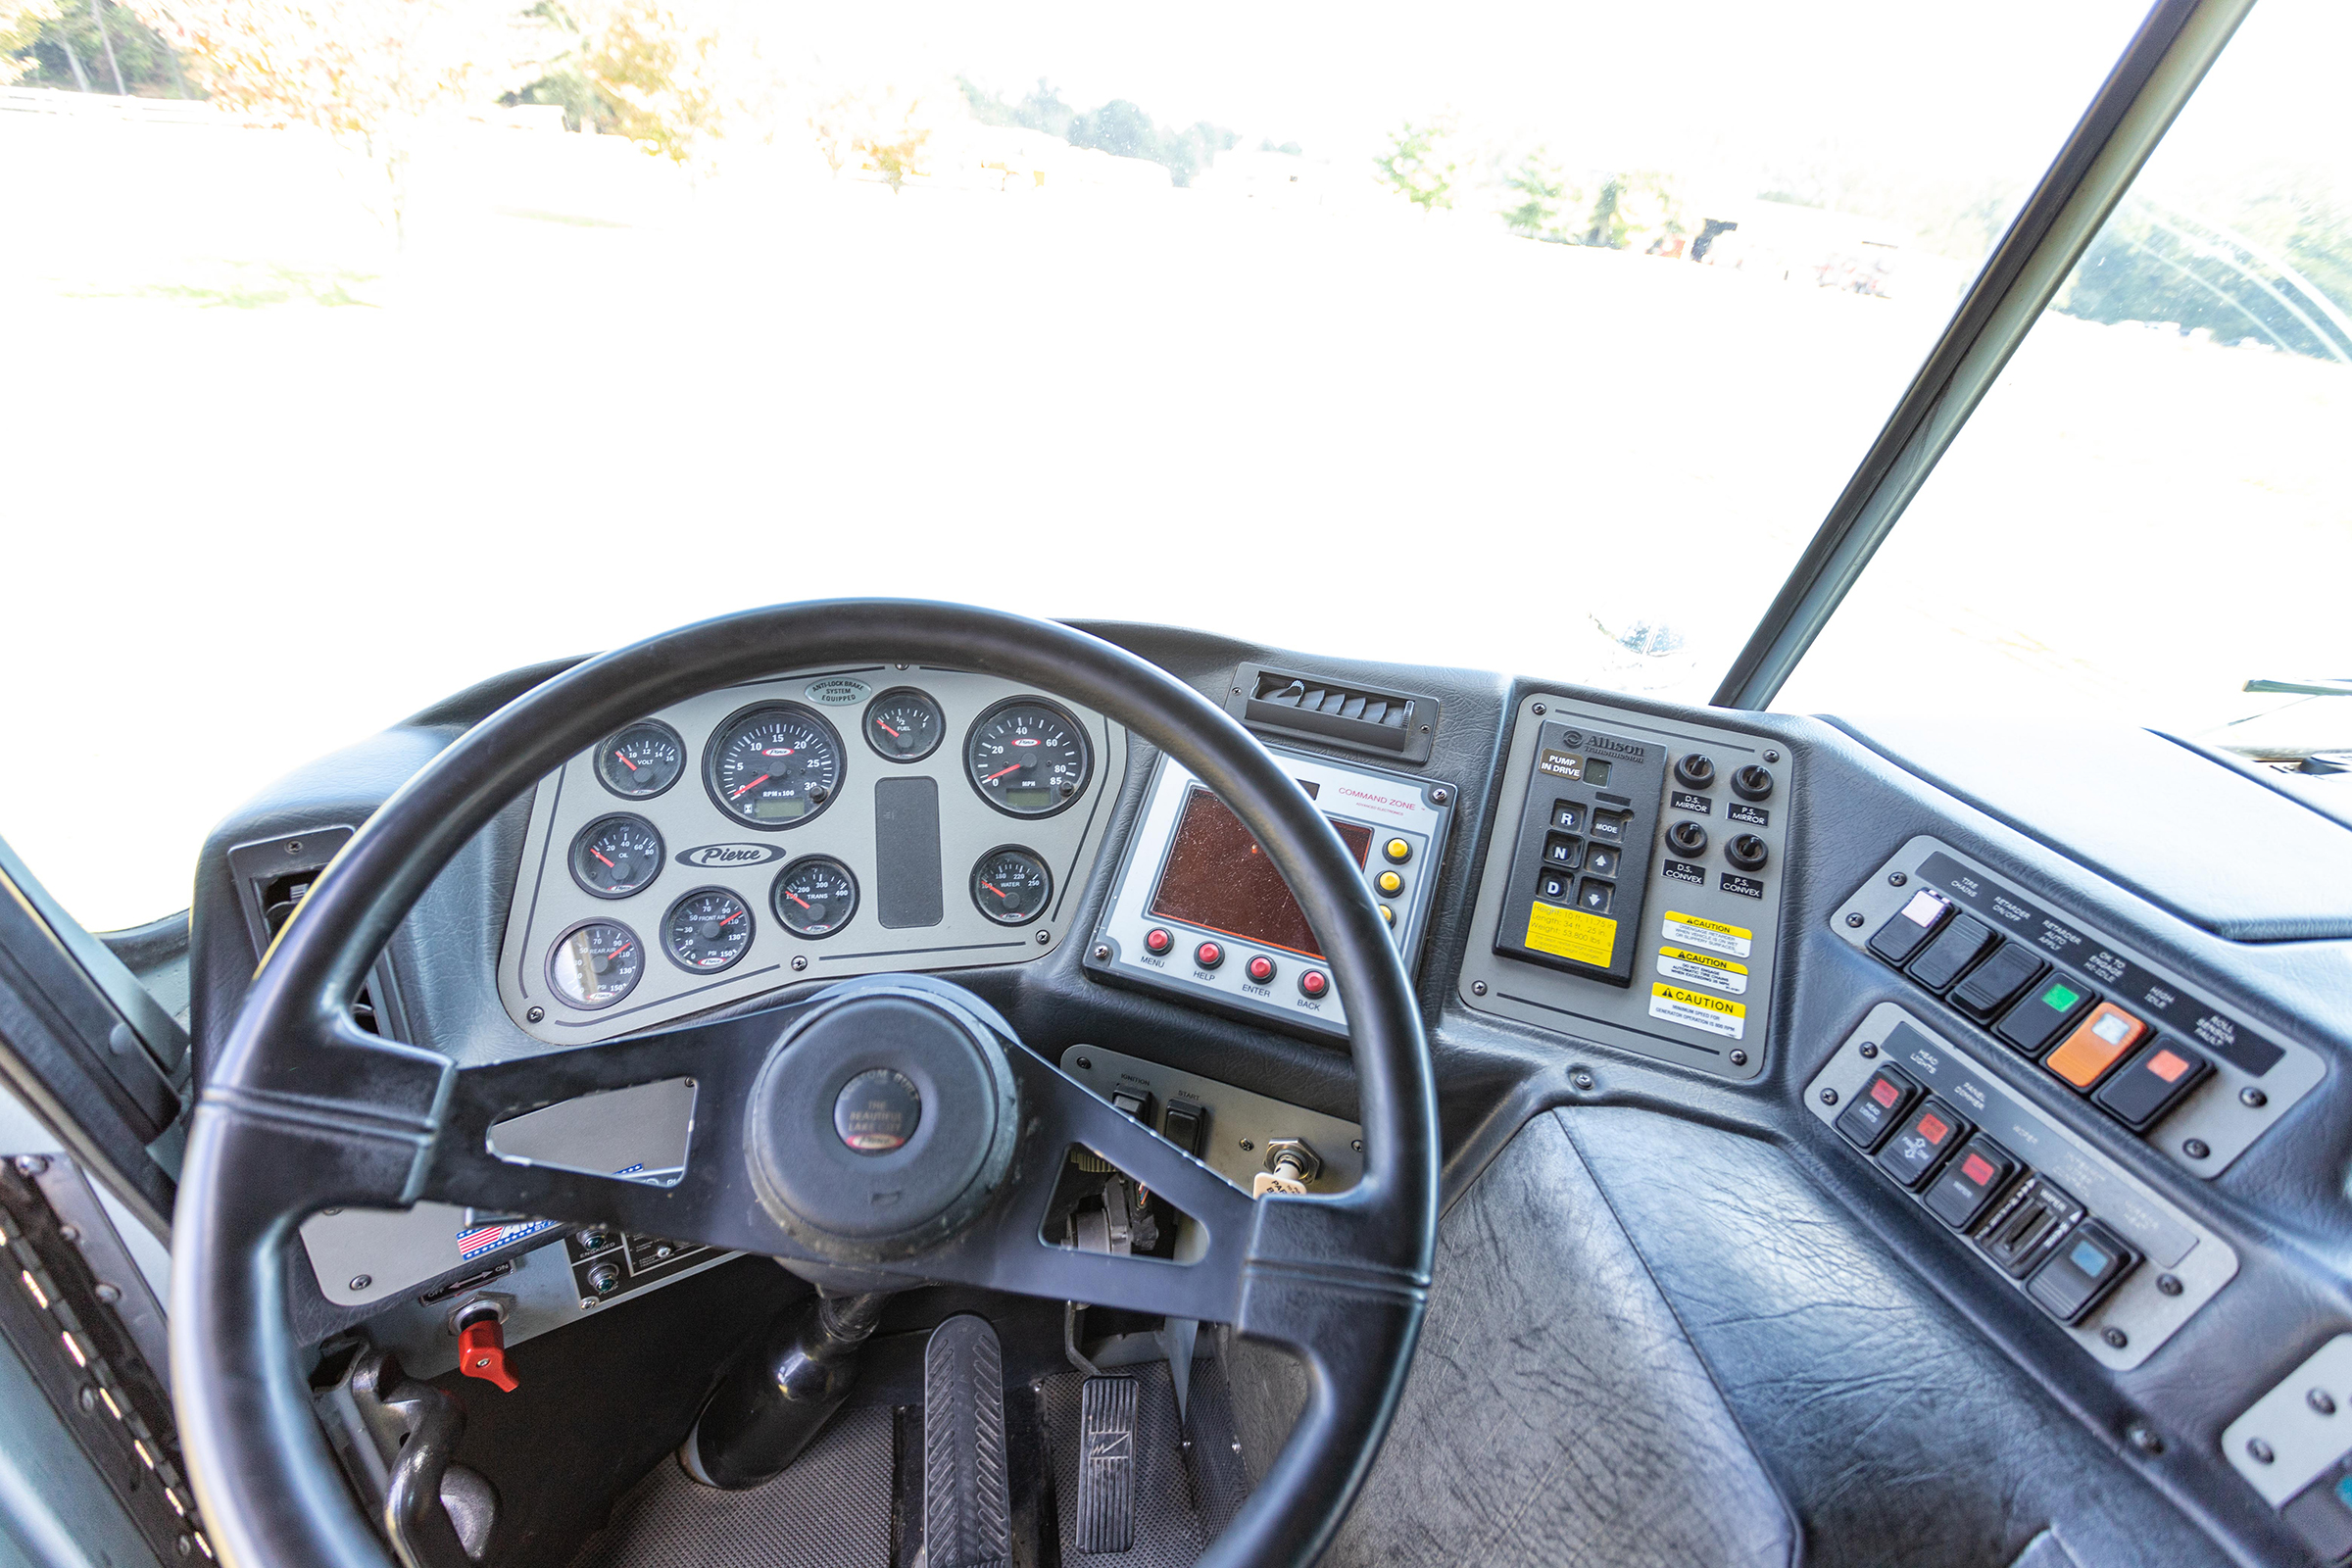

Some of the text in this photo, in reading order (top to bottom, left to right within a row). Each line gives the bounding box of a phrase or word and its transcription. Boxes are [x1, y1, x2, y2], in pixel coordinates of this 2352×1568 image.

[813, 681, 864, 692] ANTI-LOCK BRAKE
[1586, 736, 1645, 757] Allison
[1549, 755, 1576, 766] PUMP
[1585, 746, 1644, 764] Transmission
[1553, 765, 1580, 776] DRIVE
[1339, 787, 1416, 810] COMMAND ZONE
[1685, 795, 1700, 804] D.S.
[1676, 801, 1707, 812] MIRROR
[1742, 807, 1755, 815] P.S.
[1561, 813, 1573, 825] R
[1732, 813, 1764, 824] MIRROR
[1595, 823, 1617, 833] MODE
[701, 847, 761, 863] Pierce
[1554, 847, 1566, 859] N
[1677, 864, 1692, 873] D.S.
[1666, 870, 1702, 884] CONVEX
[1735, 878, 1749, 886] P.S.
[1963, 878, 1978, 889] TIRE
[1547, 881, 1559, 894] D
[1723, 883, 1760, 897] CONVEX
[1951, 880, 1977, 897] CHAINS
[1993, 904, 2021, 922] ON/OFF
[1994, 897, 2031, 920] RETARDER
[1532, 913, 1561, 924] Length:
[1534, 905, 1562, 916] Height:
[1586, 917, 1605, 927] 11.75
[1531, 922, 1560, 933] Weight:
[1679, 925, 1735, 941] DISENGAGE RETARDER
[1693, 920, 1730, 933] CAUTION
[2042, 920, 2082, 945] RETARDER
[1685, 935, 1707, 943] SLIPPERY
[2039, 936, 2061, 951] APPLY
[2045, 931, 2067, 945] AUTO
[1141, 956, 1165, 968] MENU
[1686, 953, 1727, 968] CAUTION
[2089, 955, 2124, 977] ENGAGE
[2099, 952, 2126, 969] OK TO
[1193, 971, 1215, 981] HELP
[1672, 965, 1698, 974] AUTOMATIC
[2083, 962, 2116, 983] HI-IDLE
[1242, 984, 1270, 997] ENTER
[2150, 986, 2175, 1003] HIGH
[1298, 999, 1320, 1012] BACK
[1676, 992, 1733, 1013] CAUTION
[2144, 994, 2167, 1009] IDLE
[1656, 1007, 1682, 1017] GENERATOR
[1683, 1014, 1708, 1025] OPERATION
[1672, 1005, 1694, 1013] MINIMUM
[2210, 1015, 2234, 1033] ROLL
[2194, 1028, 2224, 1046] FAULT
[2196, 1018, 2235, 1045] SENSOR
[1910, 1053, 1937, 1074] LIGHTS
[1918, 1049, 1938, 1065] HEAD
[1121, 1073, 1150, 1086] IGNITION
[1178, 1090, 1200, 1101] START
[1954, 1086, 1985, 1111] DIMMER
[1964, 1082, 1985, 1102] PANEL
[1859, 1106, 1877, 1123] LIGHTS
[1866, 1102, 1881, 1116] HEAD
[2040, 1189, 2066, 1213] WIPER
[580, 1242, 615, 1258] ENGAGED
[495, 1264, 509, 1272] ON
[428, 1288, 444, 1298] OFF
